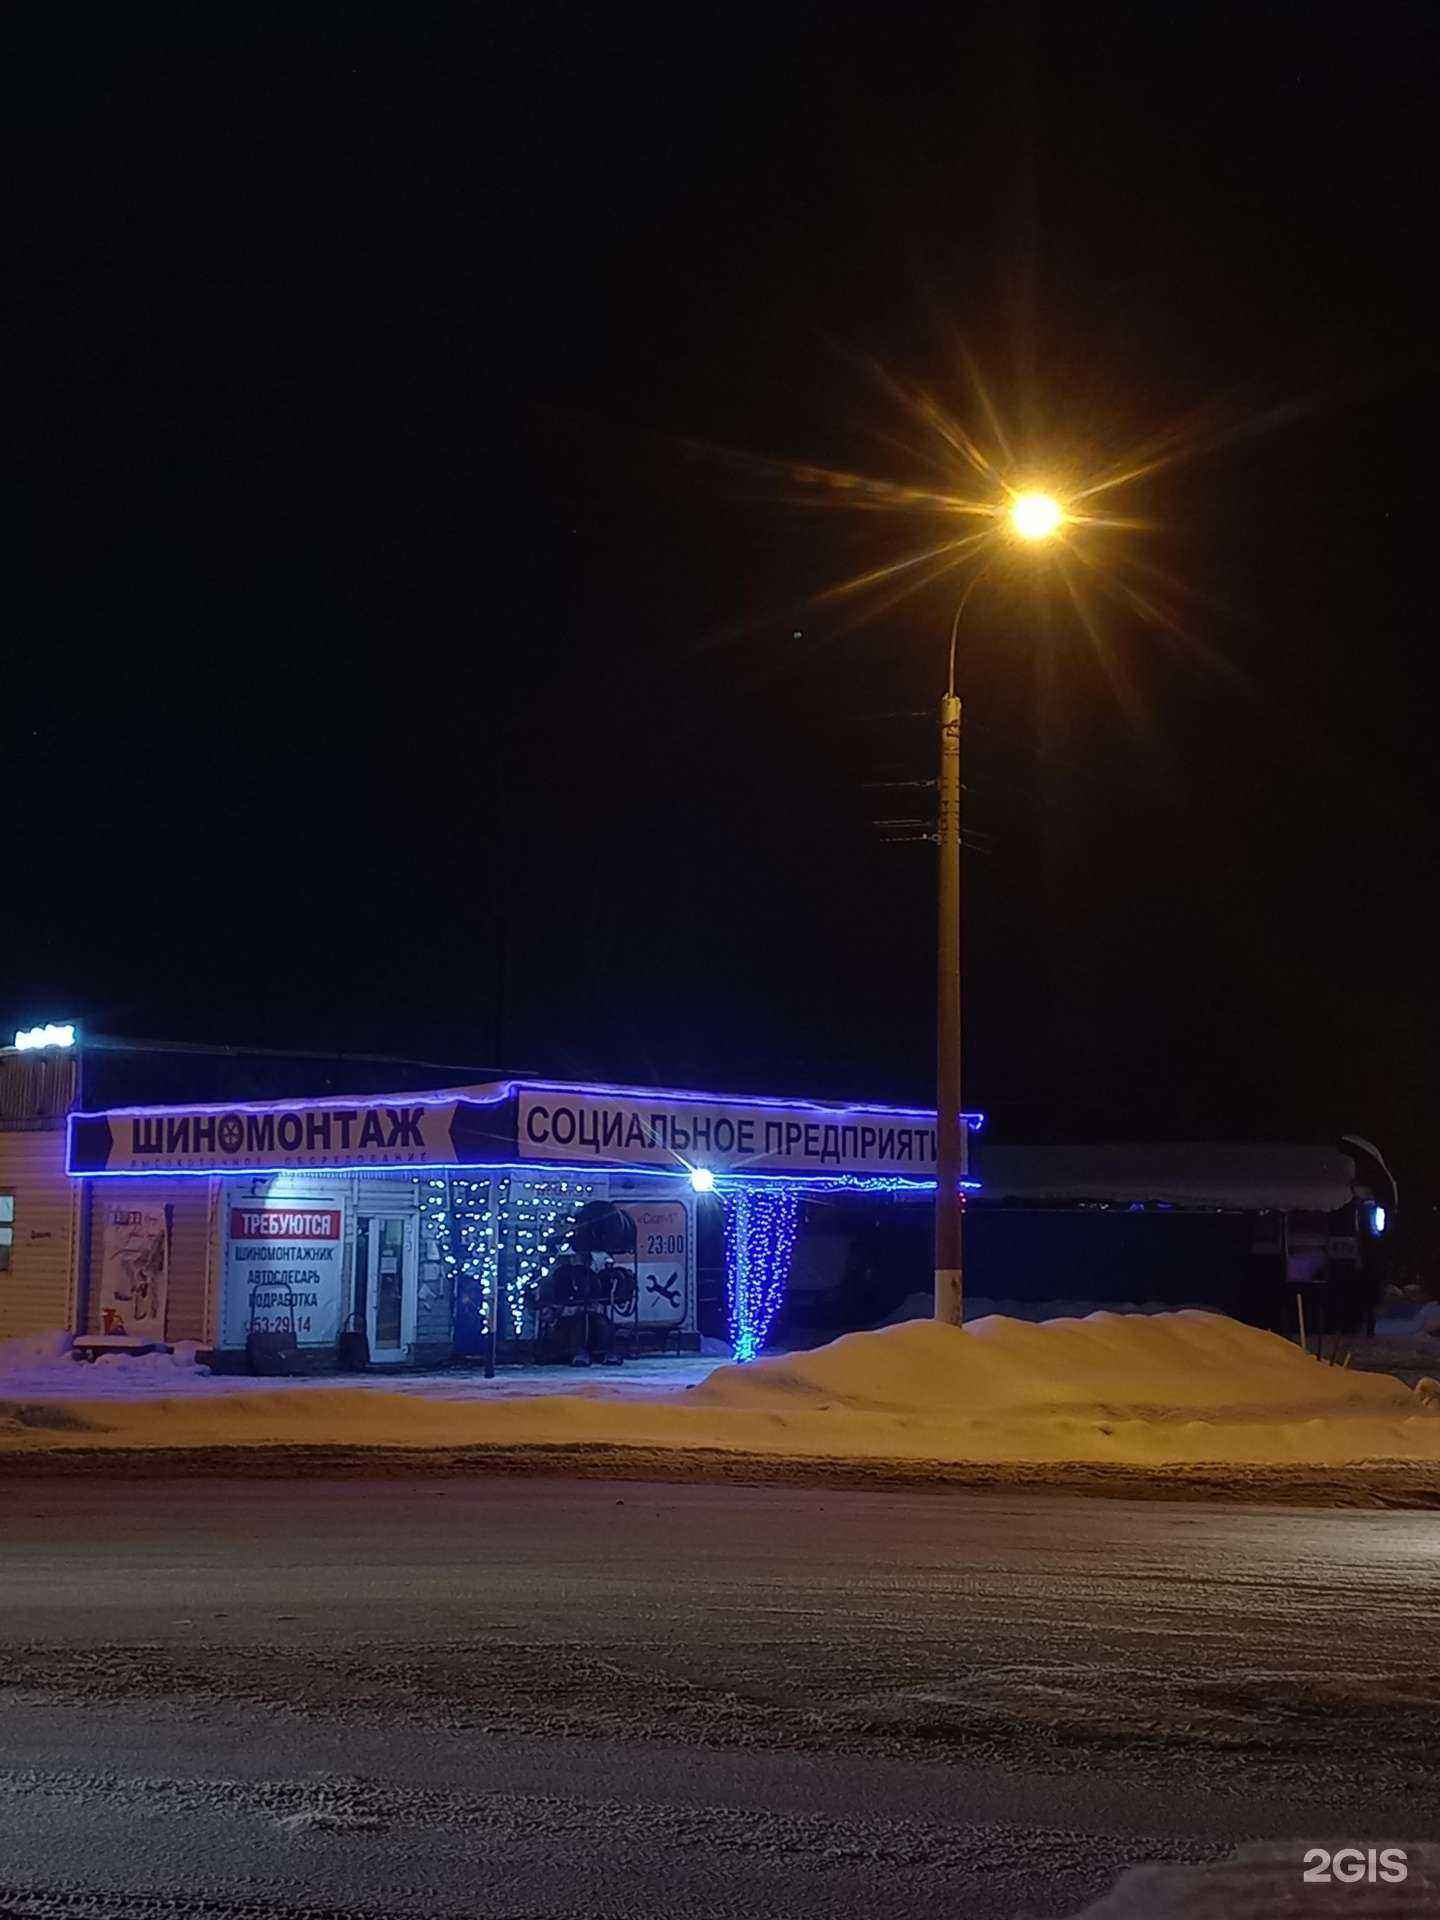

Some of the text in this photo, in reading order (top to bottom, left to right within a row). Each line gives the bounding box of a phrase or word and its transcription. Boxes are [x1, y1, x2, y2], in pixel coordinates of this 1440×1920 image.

[132, 1107, 426, 1154] ШИНОМОНТАЖ
[526, 1105, 937, 1164] СОЦИАЛЬНОЕ ПРЕДПРИЯТ
[242, 1213, 332, 1235] ТРЕБУЮТСЯ
[235, 1246, 334, 1261] ШИНОМОНТАЖНИК
[648, 1234, 684, 1254] 23:00
[247, 1269, 320, 1284] АВТОСЛЕСАРЬ
[249, 1292, 317, 1309] ПОДРАБОТКА
